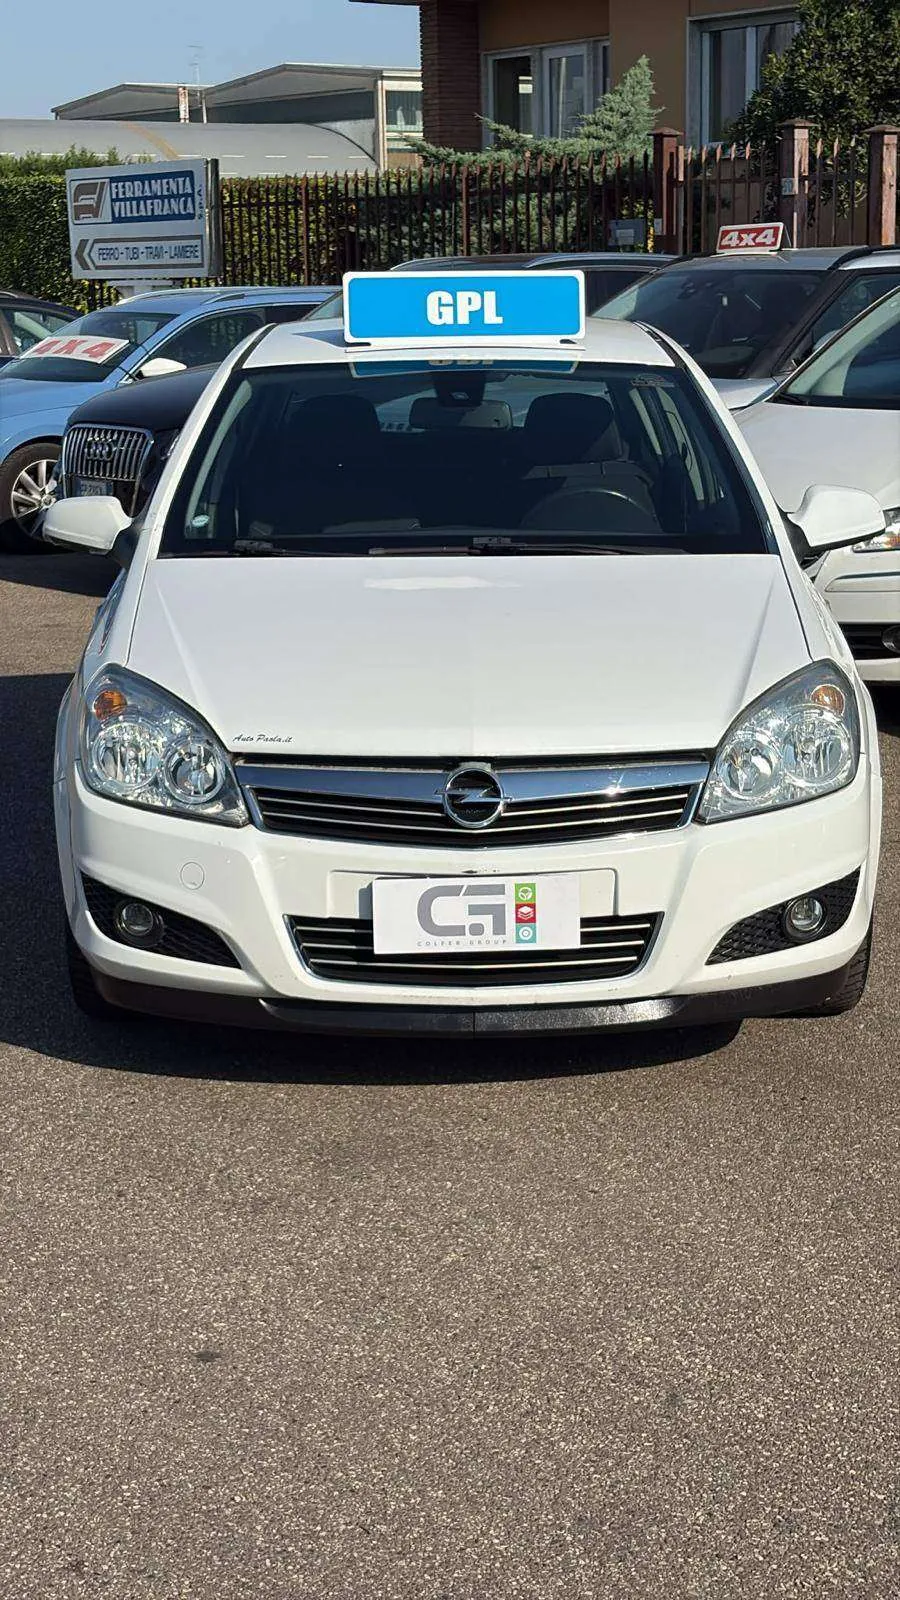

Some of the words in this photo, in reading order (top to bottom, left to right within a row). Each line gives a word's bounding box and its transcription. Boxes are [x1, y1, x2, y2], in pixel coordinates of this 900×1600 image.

[111, 177, 193, 200] FERRAMENTA
[112, 197, 194, 218] VILLAFRANCA
[720, 228, 776, 247] 4x4
[98, 247, 119, 261] FERRO
[168, 245, 199, 259] LAMIERE
[426, 290, 504, 326] GPL
[232, 734, 254, 742] Auto
[256, 734, 293, 743] Paola.it
